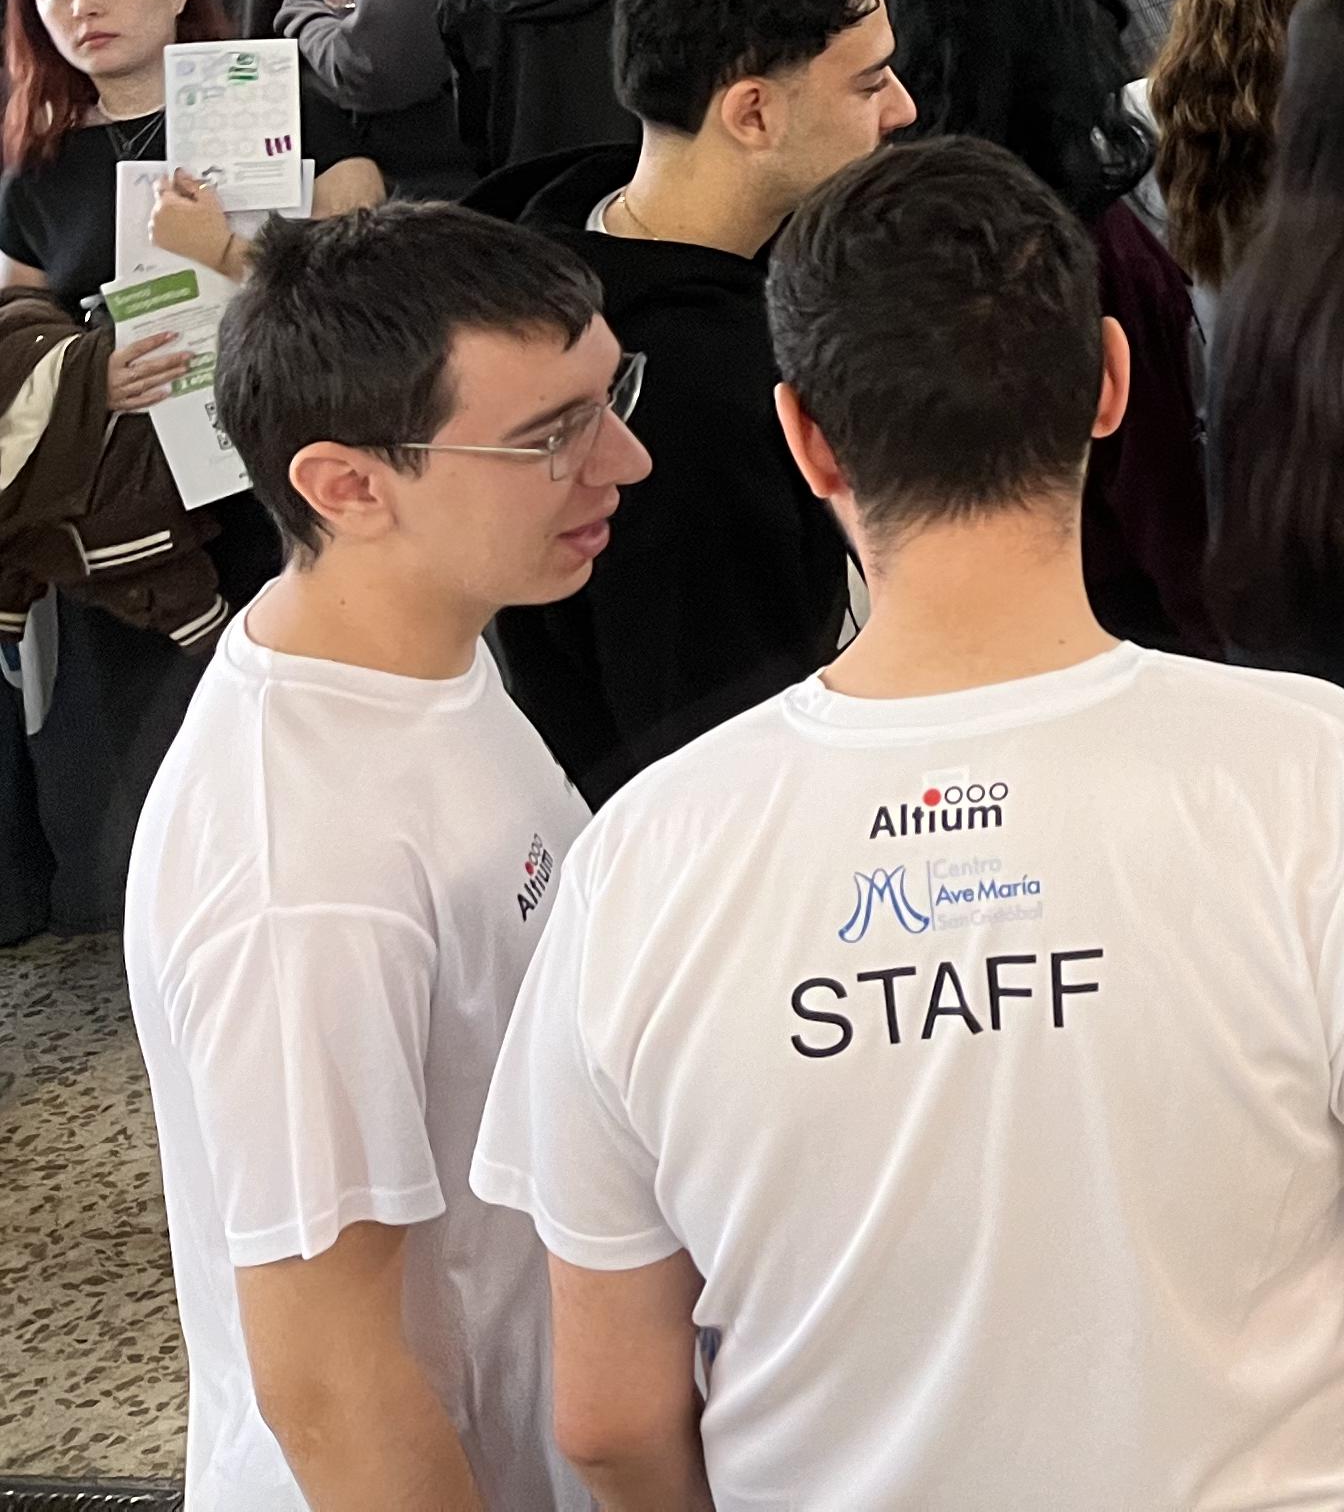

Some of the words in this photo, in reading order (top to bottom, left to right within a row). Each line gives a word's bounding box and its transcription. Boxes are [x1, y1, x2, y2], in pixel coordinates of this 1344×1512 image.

[870, 801, 1003, 839] Altium
[933, 856, 1002, 879] Centro
[790, 948, 1104, 1059] STAFF
